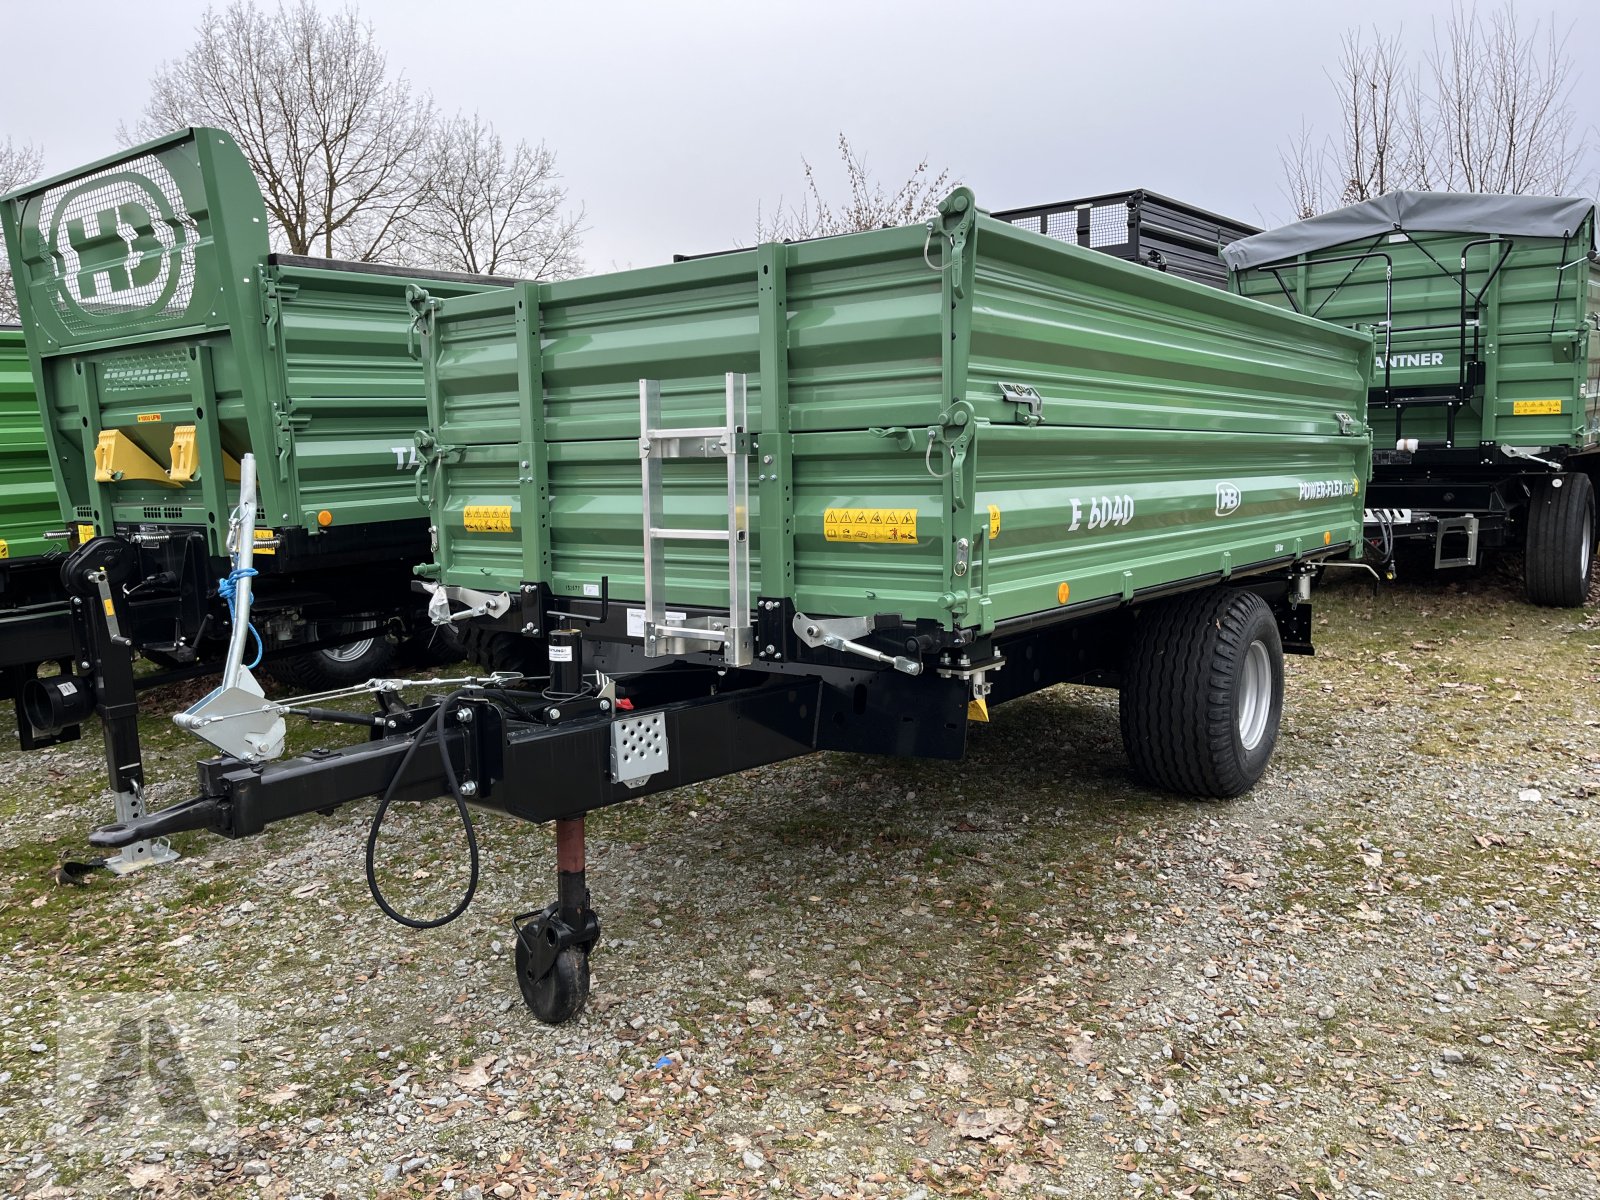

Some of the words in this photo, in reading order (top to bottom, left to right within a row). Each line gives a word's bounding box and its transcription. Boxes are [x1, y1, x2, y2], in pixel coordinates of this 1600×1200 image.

[1298, 479, 1343, 501] POWER-FLEX
[1067, 498, 1082, 532] E
[1087, 494, 1135, 530] 6040
